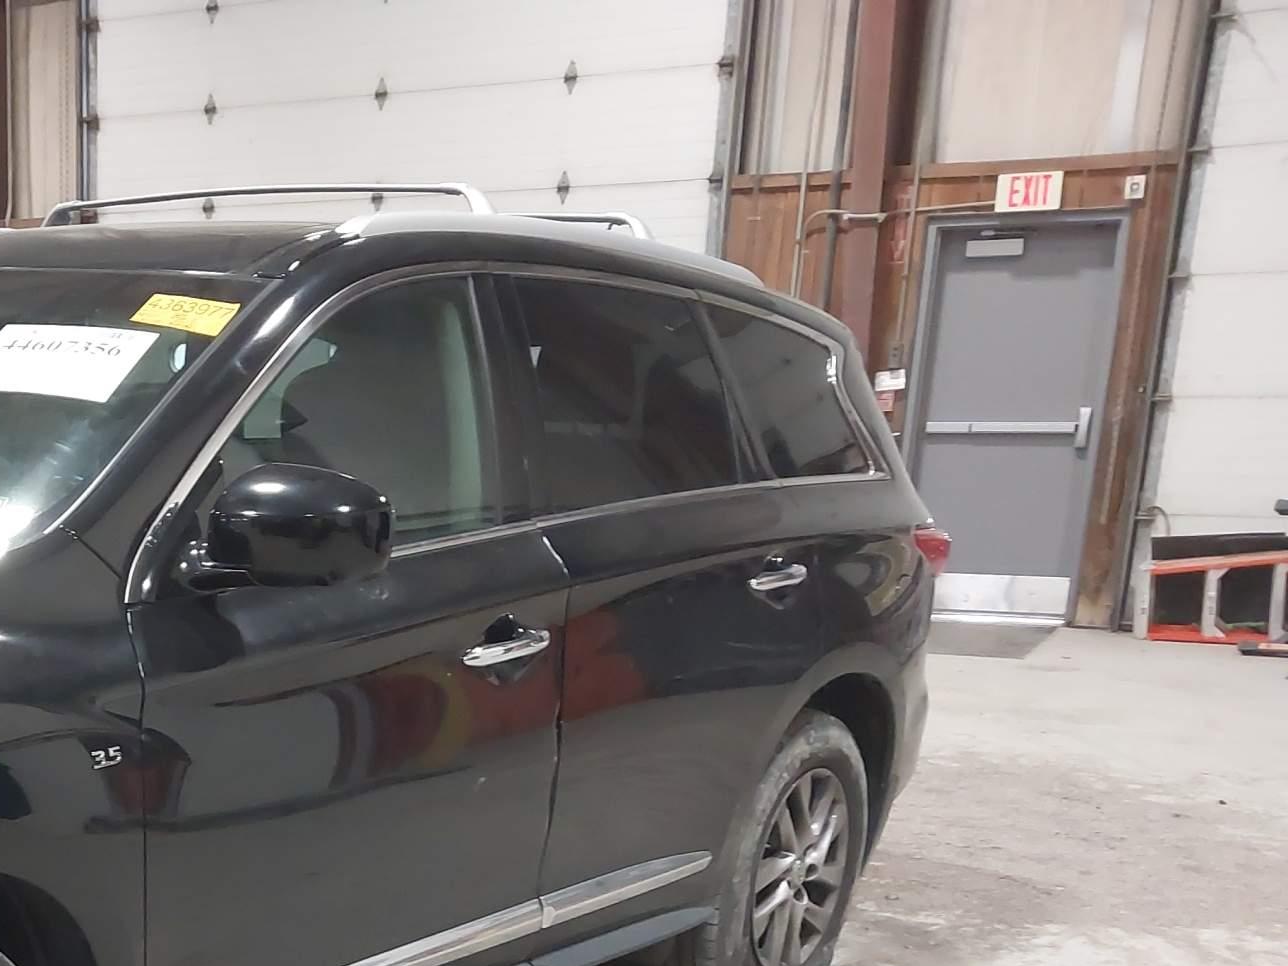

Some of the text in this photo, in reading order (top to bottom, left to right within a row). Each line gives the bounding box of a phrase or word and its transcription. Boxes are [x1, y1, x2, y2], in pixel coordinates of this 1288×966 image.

[1007, 174, 1053, 208] EXIT
[148, 298, 235, 319] 4363977
[2, 339, 122, 357] 44607356
